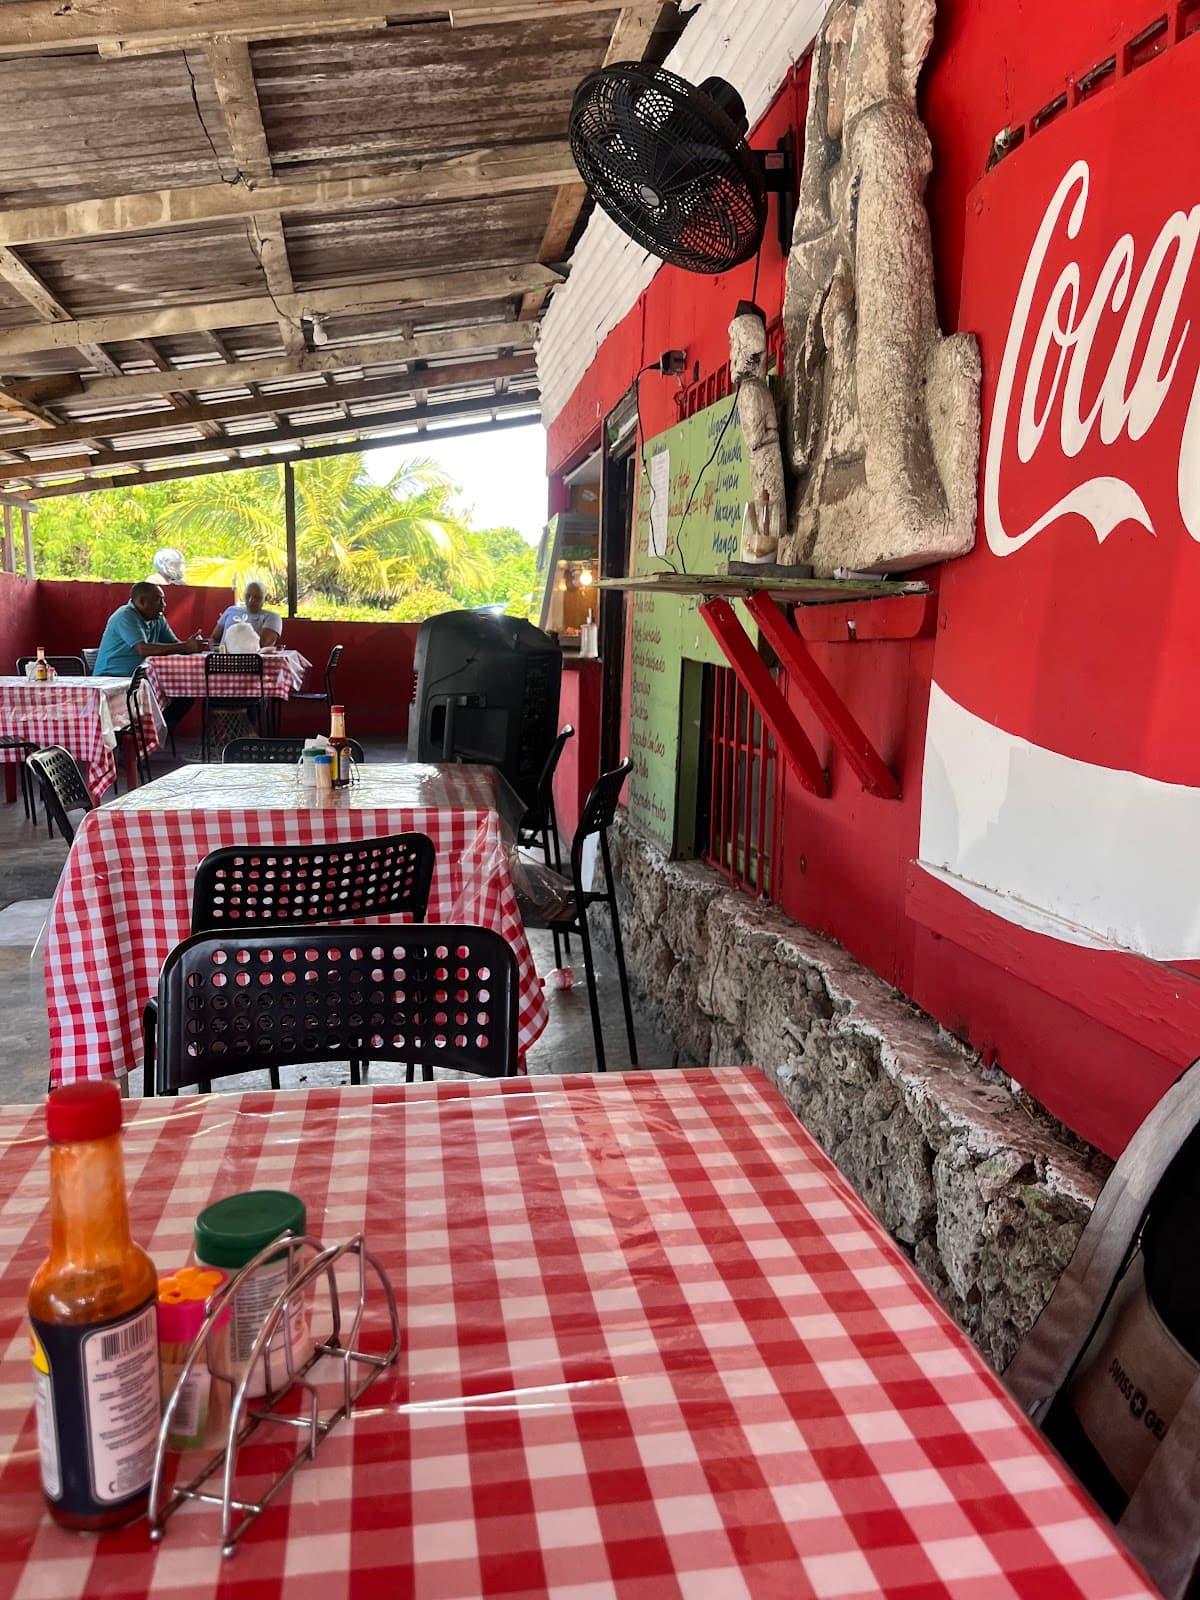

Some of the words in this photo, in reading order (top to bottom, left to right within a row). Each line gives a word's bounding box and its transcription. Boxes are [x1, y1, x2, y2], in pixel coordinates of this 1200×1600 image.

[984, 160, 1200, 557] Coca
[712, 531, 738, 560] Mango
[1108, 1357, 1135, 1401] SWISS
